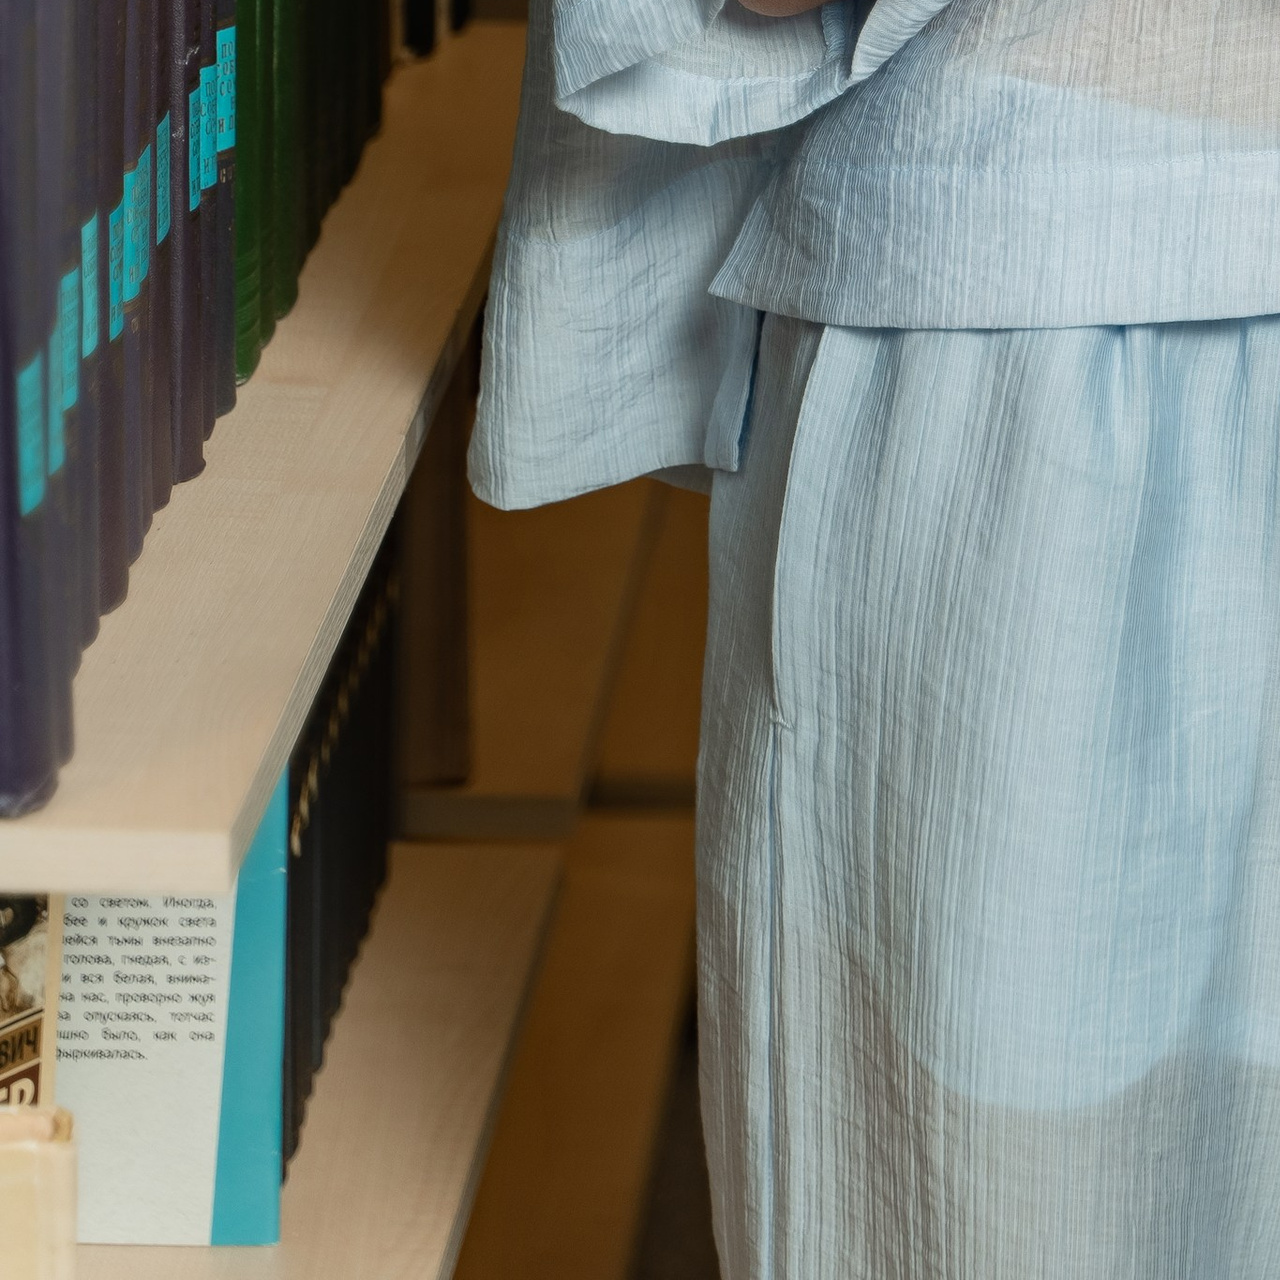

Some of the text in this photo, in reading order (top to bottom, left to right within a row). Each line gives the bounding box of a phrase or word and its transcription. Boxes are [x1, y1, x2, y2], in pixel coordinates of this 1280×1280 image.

[71, 897, 89, 908] со
[162, 896, 218, 910] Иногда,
[117, 917, 169, 930] кружок
[178, 917, 217, 927] света
[62, 933, 217, 946] ейся тьмы внезапно
[121, 954, 172, 968] гнедая,
[177, 954, 187, 966] с
[80, 973, 104, 984] вся
[113, 970, 157, 985] белая,
[166, 973, 216, 984] внима-
[58, 992, 216, 1006] на нас, проворно жуя
[168, 1011, 216, 1022] тотчас
[56, 1027, 215, 1042] шно было, как она
